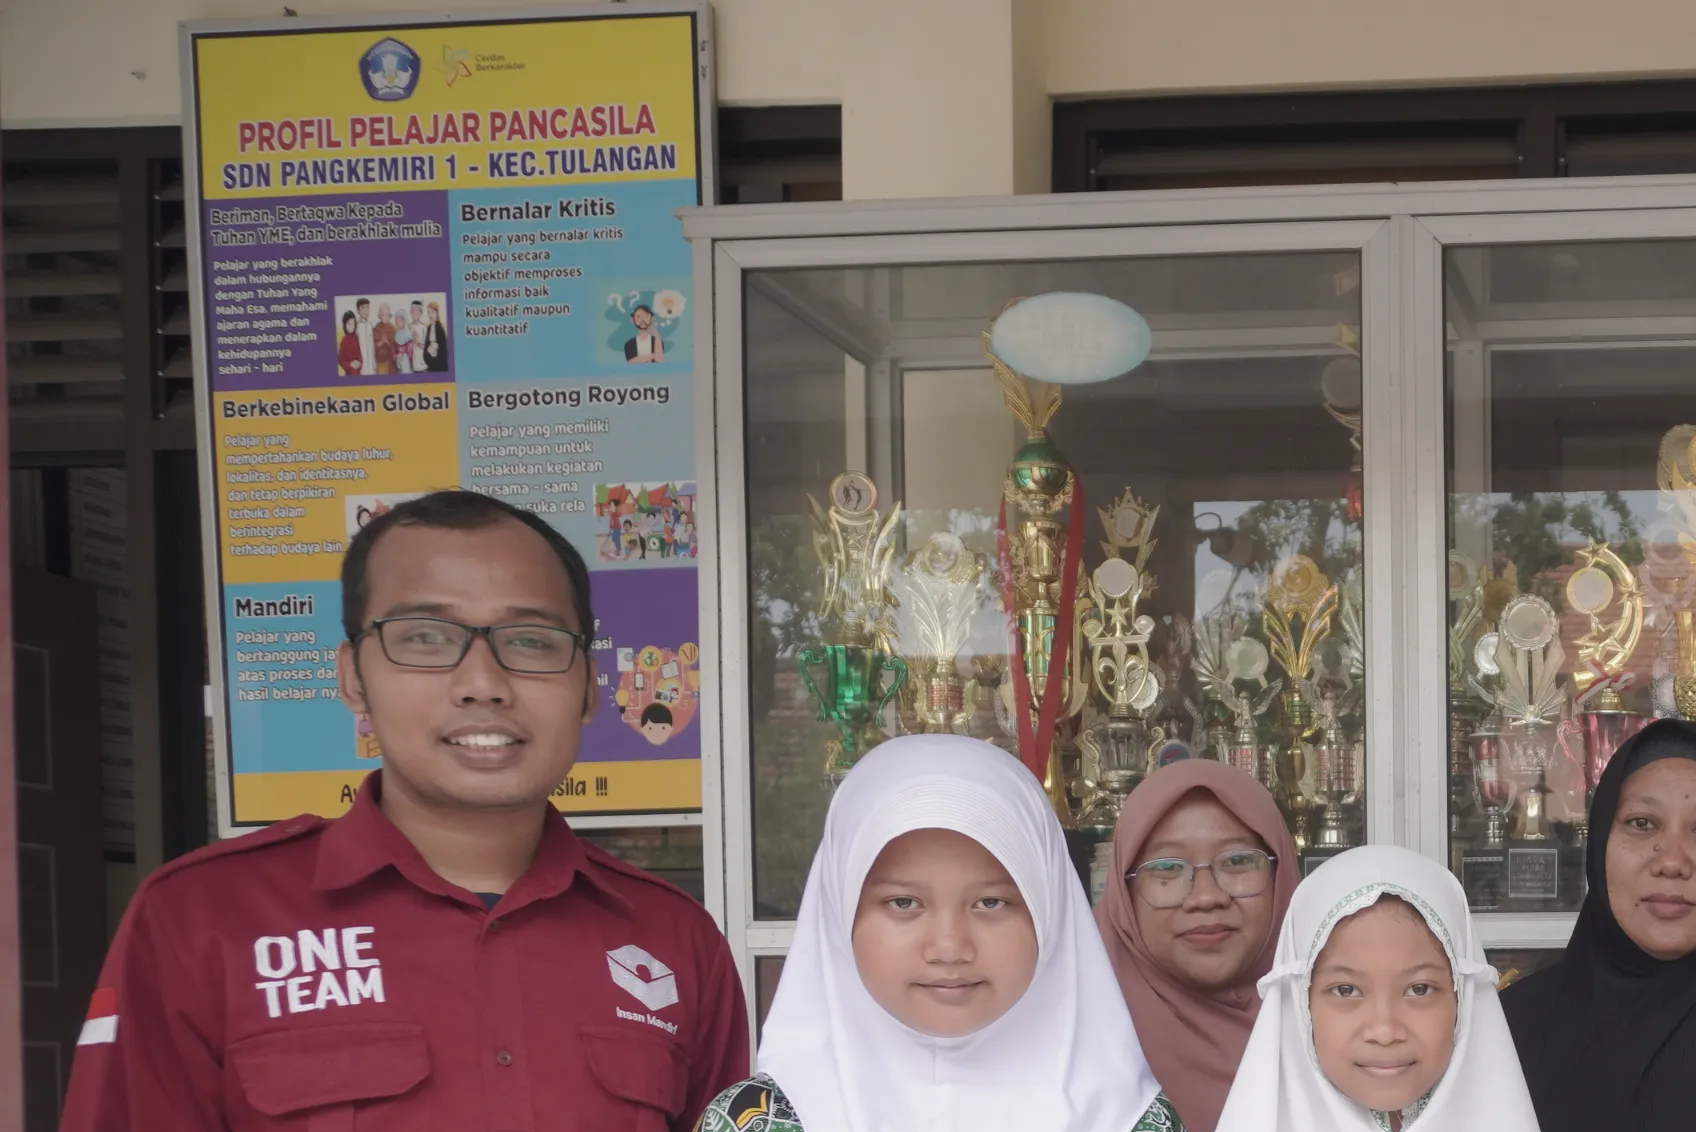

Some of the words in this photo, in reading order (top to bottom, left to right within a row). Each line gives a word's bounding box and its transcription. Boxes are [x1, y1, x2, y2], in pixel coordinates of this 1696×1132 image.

[475, 54, 505, 63] Cerdas
[475, 62, 526, 72] Berkarakter
[239, 118, 342, 153] PROFIL
[350, 111, 481, 149] PELAJAR
[489, 104, 656, 142] PANCASILA
[223, 161, 271, 189] SDN
[281, 155, 435, 187] PANGKEMIRI
[446, 153, 457, 179] 1
[489, 144, 676, 178] KEC.TULANGAN
[211, 209, 274, 225] Beriman,
[277, 205, 345, 223] Bertaqwa
[348, 202, 403, 219] Kepada
[461, 201, 552, 221] Bernalar
[559, 198, 616, 218] Kritis
[211, 229, 255, 246] Tuhan
[258, 228, 294, 245] YME,
[297, 225, 324, 242] dan
[326, 222, 398, 241] berakhlak
[401, 220, 442, 237] mulia
[463, 232, 503, 246] Pelajar
[506, 232, 536, 246] yang
[539, 229, 589, 242] bernalar
[593, 226, 624, 240] kritis
[213, 259, 250, 272] Pelajar
[252, 259, 279, 271] yang
[280, 256, 334, 268] berakhlak
[463, 252, 507, 265] mampu
[511, 250, 551, 262] secara
[214, 275, 247, 286] dalam
[249, 272, 321, 285] hubungannya
[464, 268, 511, 284] objektif
[514, 266, 582, 280] memproses
[214, 290, 254, 302] dengan
[256, 287, 289, 299] Tuhan
[291, 287, 318, 299] Yang
[464, 287, 521, 300] informasi
[525, 285, 549, 298] baik
[215, 304, 245, 316] Maha
[270, 300, 328, 313] memahami
[465, 305, 520, 319] kualitatif
[522, 304, 571, 317] maupun
[216, 319, 250, 332] ajaran
[252, 318, 288, 331] agama
[289, 316, 310, 328] dan
[466, 323, 529, 337] kuantitatif
[217, 333, 282, 345] menerapkan
[284, 331, 318, 343] dalam
[217, 347, 292, 360] kehidupannya
[218, 363, 252, 375] sehari
[262, 362, 284, 374] hari
[223, 397, 376, 418] Berkebinekaan
[382, 392, 450, 412] Global
[469, 389, 581, 410] Bergotong
[588, 385, 670, 405] Royong
[469, 424, 514, 440] Pelajar
[518, 424, 551, 439] yang
[554, 418, 609, 435] memiliki
[224, 434, 262, 449] Pelajar
[263, 434, 290, 448] yang
[470, 444, 551, 458] kemampuan
[555, 441, 593, 454] untuk
[225, 450, 318, 467] mempertahankan
[320, 449, 360, 463] budaya
[276, 469, 297, 482] dan
[471, 462, 543, 477] melakukan
[546, 459, 603, 477] kegiatan
[227, 489, 248, 502] dan
[250, 489, 279, 503] tetap
[281, 486, 336, 501] berpikiran
[544, 481, 579, 495] sama
[228, 506, 270, 520] terbuka
[272, 505, 306, 518] dalam
[526, 500, 557, 514] suka
[560, 498, 586, 512] rela
[229, 523, 295, 539] berintegrasi
[230, 542, 279, 557] terhadap
[281, 541, 321, 556] budaya
[235, 596, 313, 617] Mandiri
[235, 629, 280, 646] Pelajar
[283, 630, 316, 645] yang
[236, 649, 320, 665] bertanggung
[323, 646, 339, 663] ja
[237, 669, 266, 683] atas
[269, 669, 313, 683] proses
[238, 686, 269, 701] hasil
[272, 685, 318, 702] belajar
[254, 926, 381, 979] ONE
[255, 968, 386, 1019] TEAM
[615, 1006, 645, 1023] Insan
